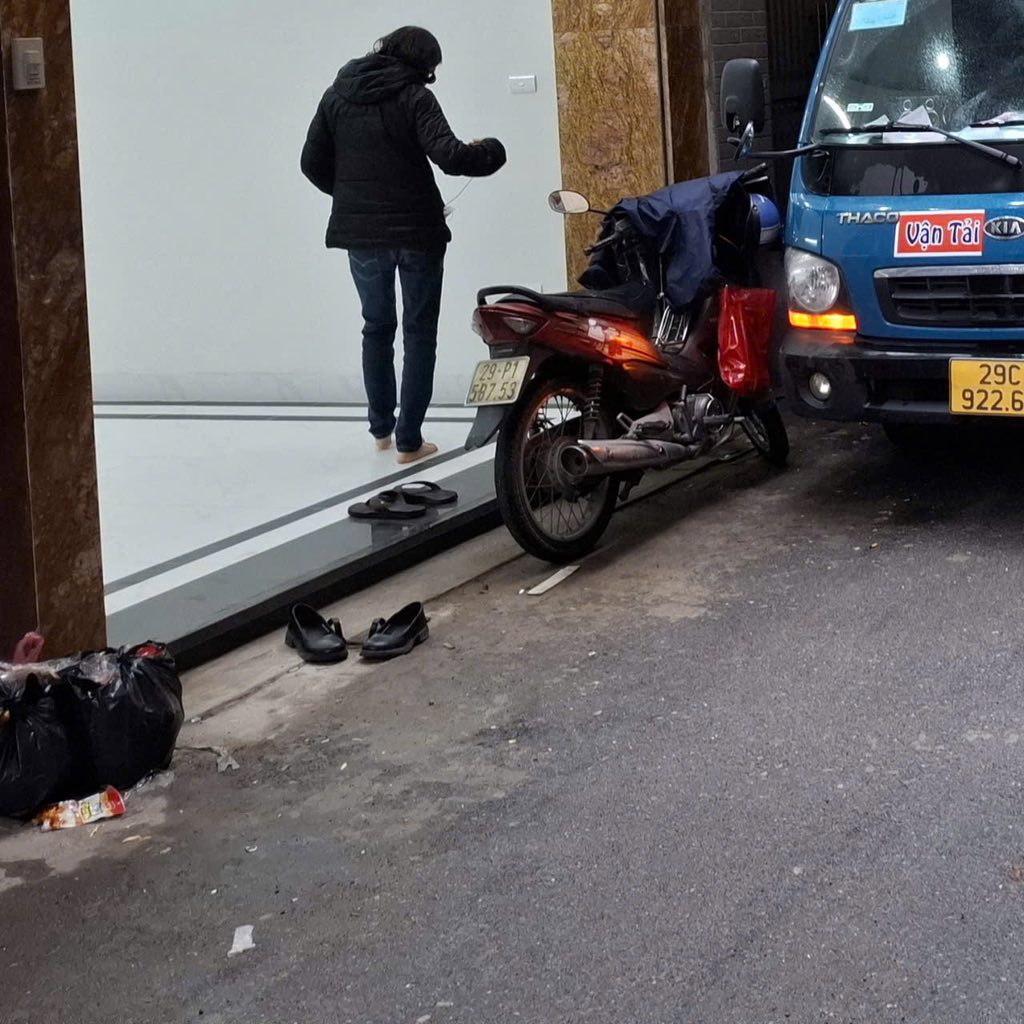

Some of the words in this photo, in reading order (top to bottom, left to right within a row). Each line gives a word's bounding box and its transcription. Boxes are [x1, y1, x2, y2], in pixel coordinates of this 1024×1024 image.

[837, 211, 899, 224] THACO
[989, 219, 1023, 236] KIA
[906, 220, 943, 251] Vận
[948, 218, 980, 244] Tải
[479, 361, 519, 381] 29-P1
[979, 364, 1021, 385] 29C
